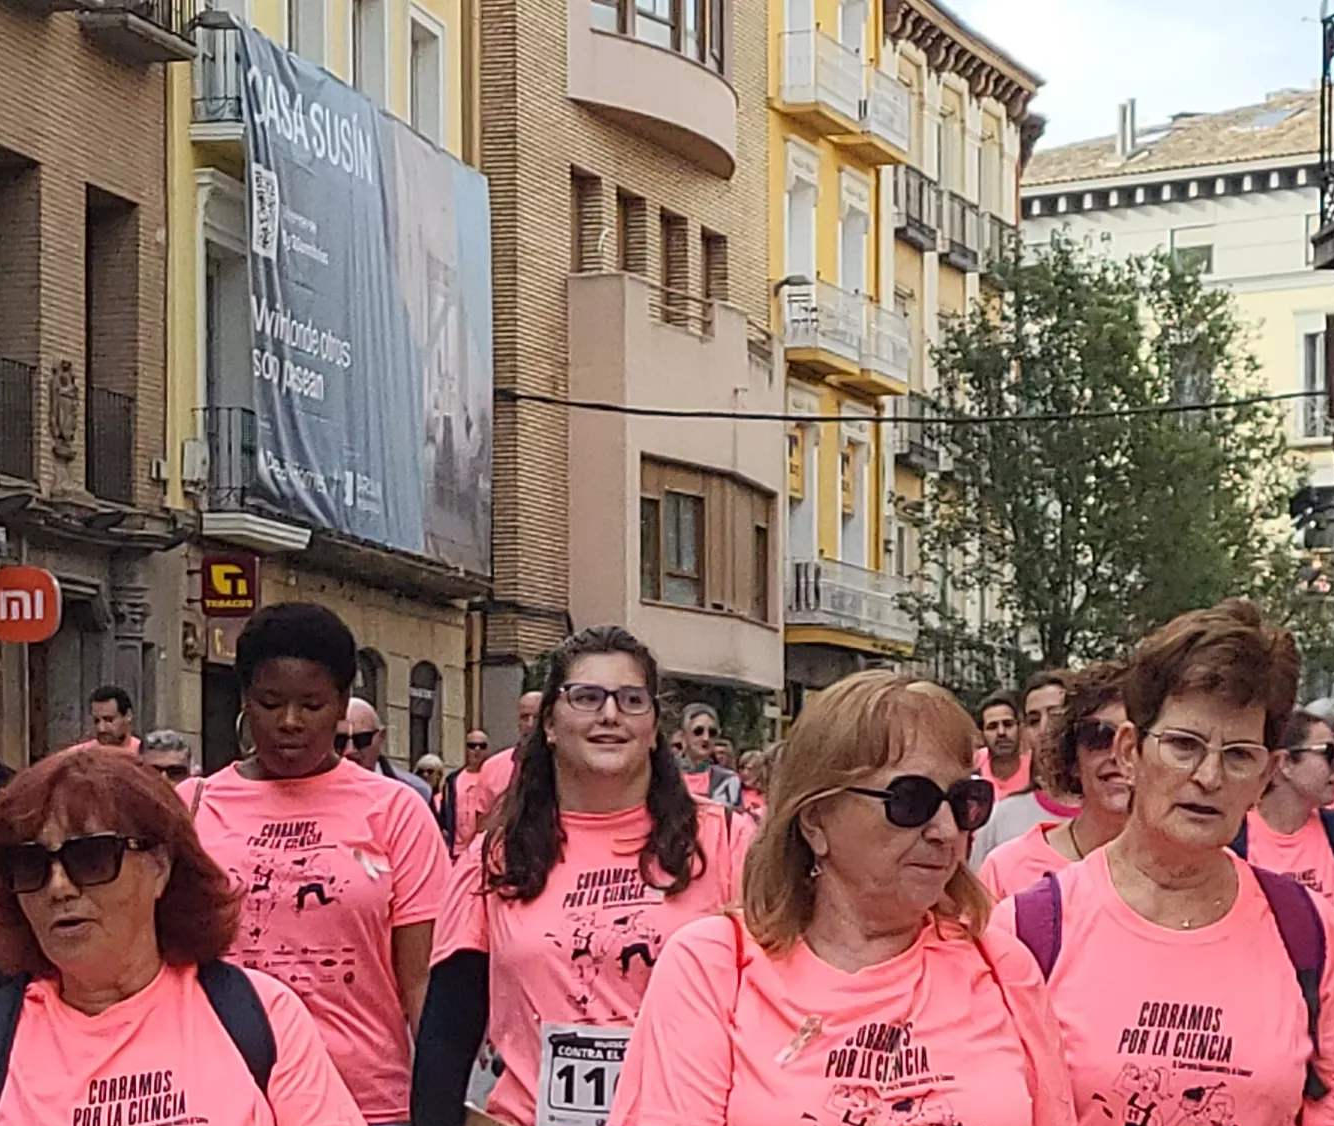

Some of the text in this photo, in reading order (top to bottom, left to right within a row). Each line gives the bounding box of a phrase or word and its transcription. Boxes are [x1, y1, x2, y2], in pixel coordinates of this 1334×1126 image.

[309, 102, 373, 185] SUSÍN
[1138, 1000, 1223, 1033] CORRAMOS
[557, 1045, 621, 1060] CONTRA EL
[1117, 1028, 1234, 1063] POR LA CIENCIA
[88, 1070, 173, 1105] CORRAMOS
[556, 1064, 621, 1107] 11
[128, 1090, 186, 1126] CIENCIA
